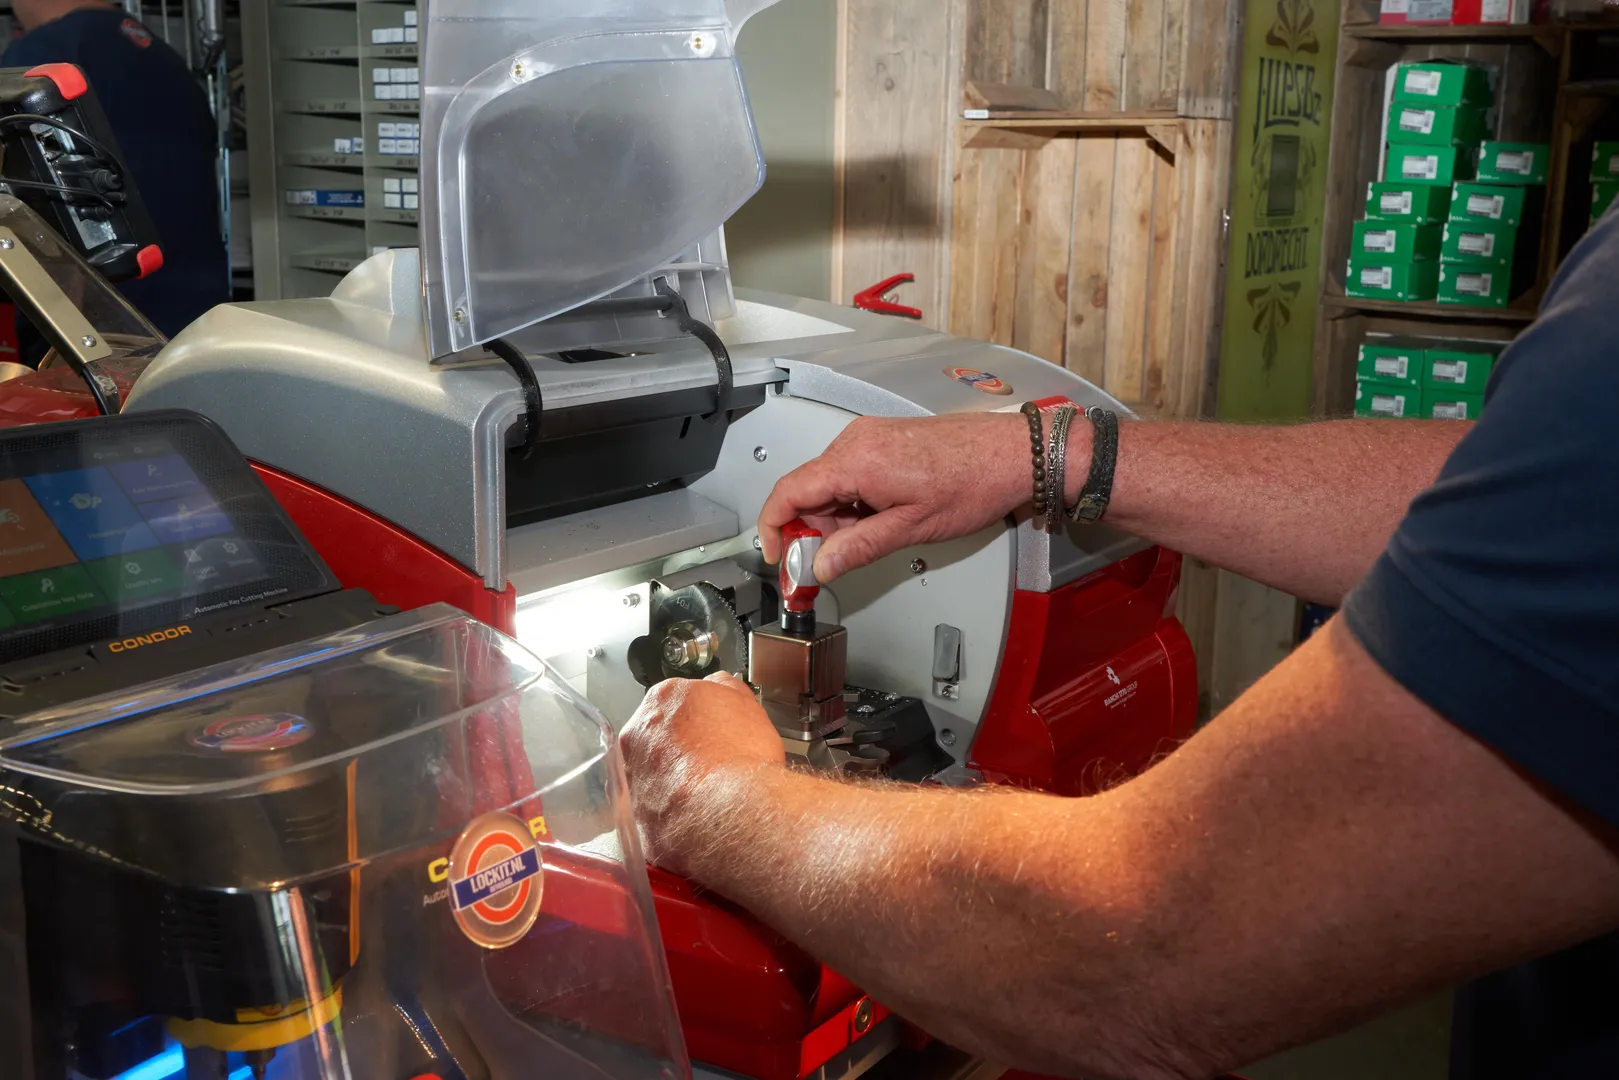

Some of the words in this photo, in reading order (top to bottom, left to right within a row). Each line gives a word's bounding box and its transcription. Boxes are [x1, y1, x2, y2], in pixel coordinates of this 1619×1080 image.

[194, 601, 229, 614] Automatic
[240, 593, 264, 602] Cutting
[263, 587, 288, 597] Machine
[109, 625, 192, 653] CONDOR
[470, 855, 526, 894] LOCKIT.NL
